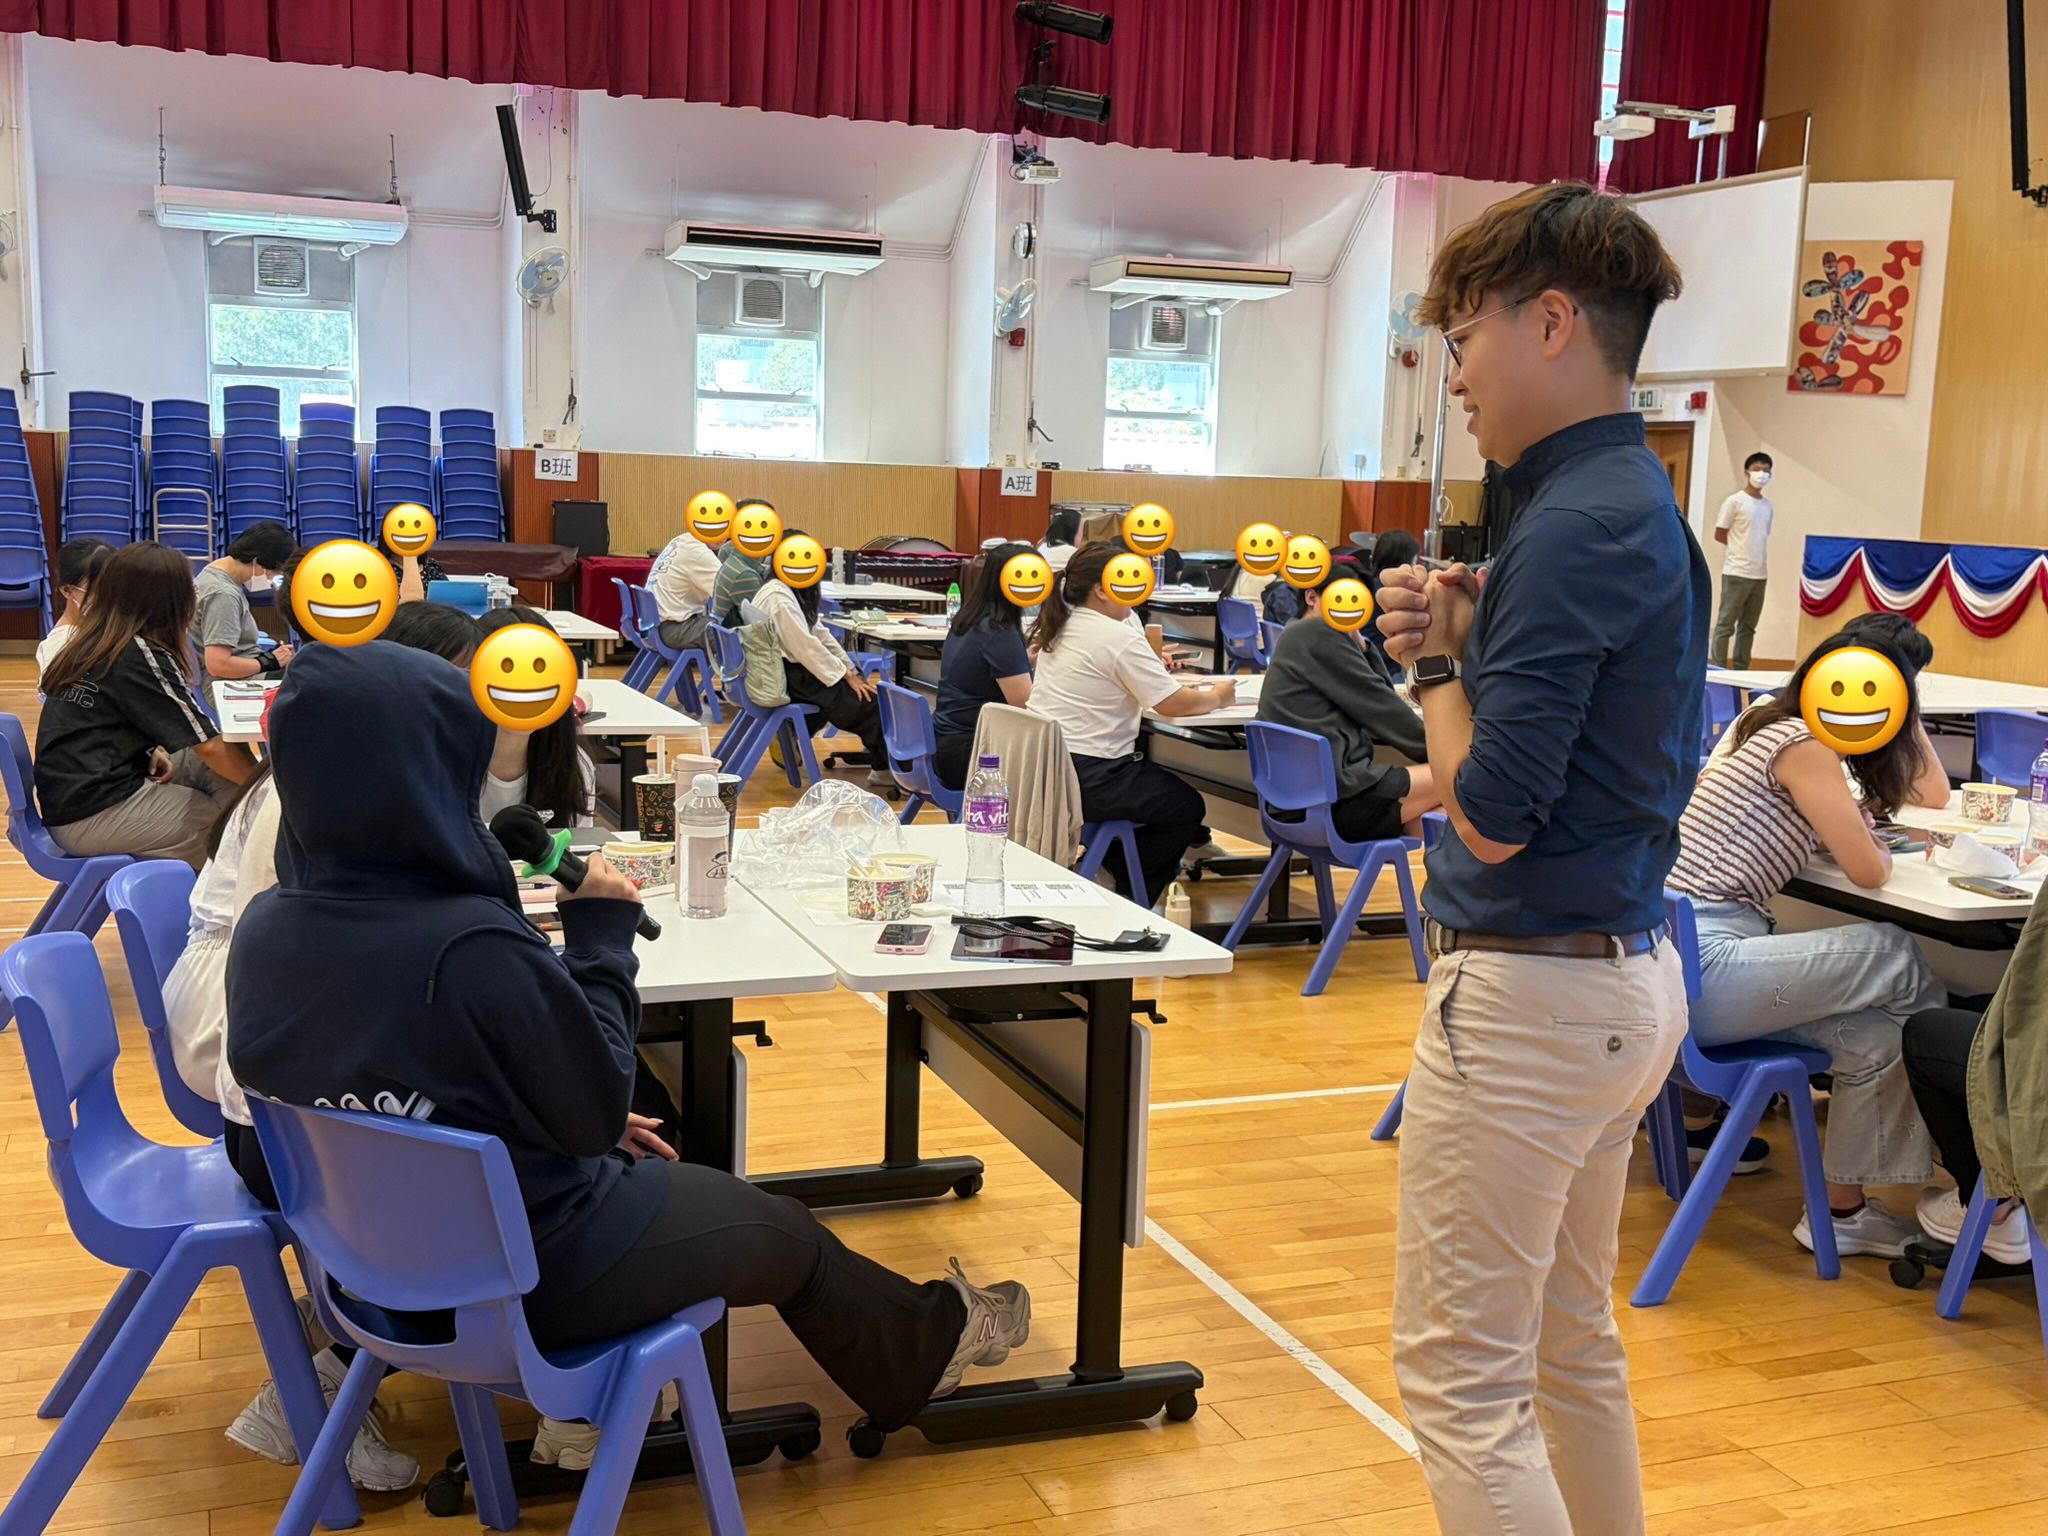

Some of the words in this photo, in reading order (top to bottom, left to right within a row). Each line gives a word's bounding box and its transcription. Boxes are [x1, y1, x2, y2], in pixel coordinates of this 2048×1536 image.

[541, 458, 572, 477] B班
[1005, 475, 1033, 492] A班
[988, 802, 1009, 825] vit
[978, 1312, 999, 1342] N
